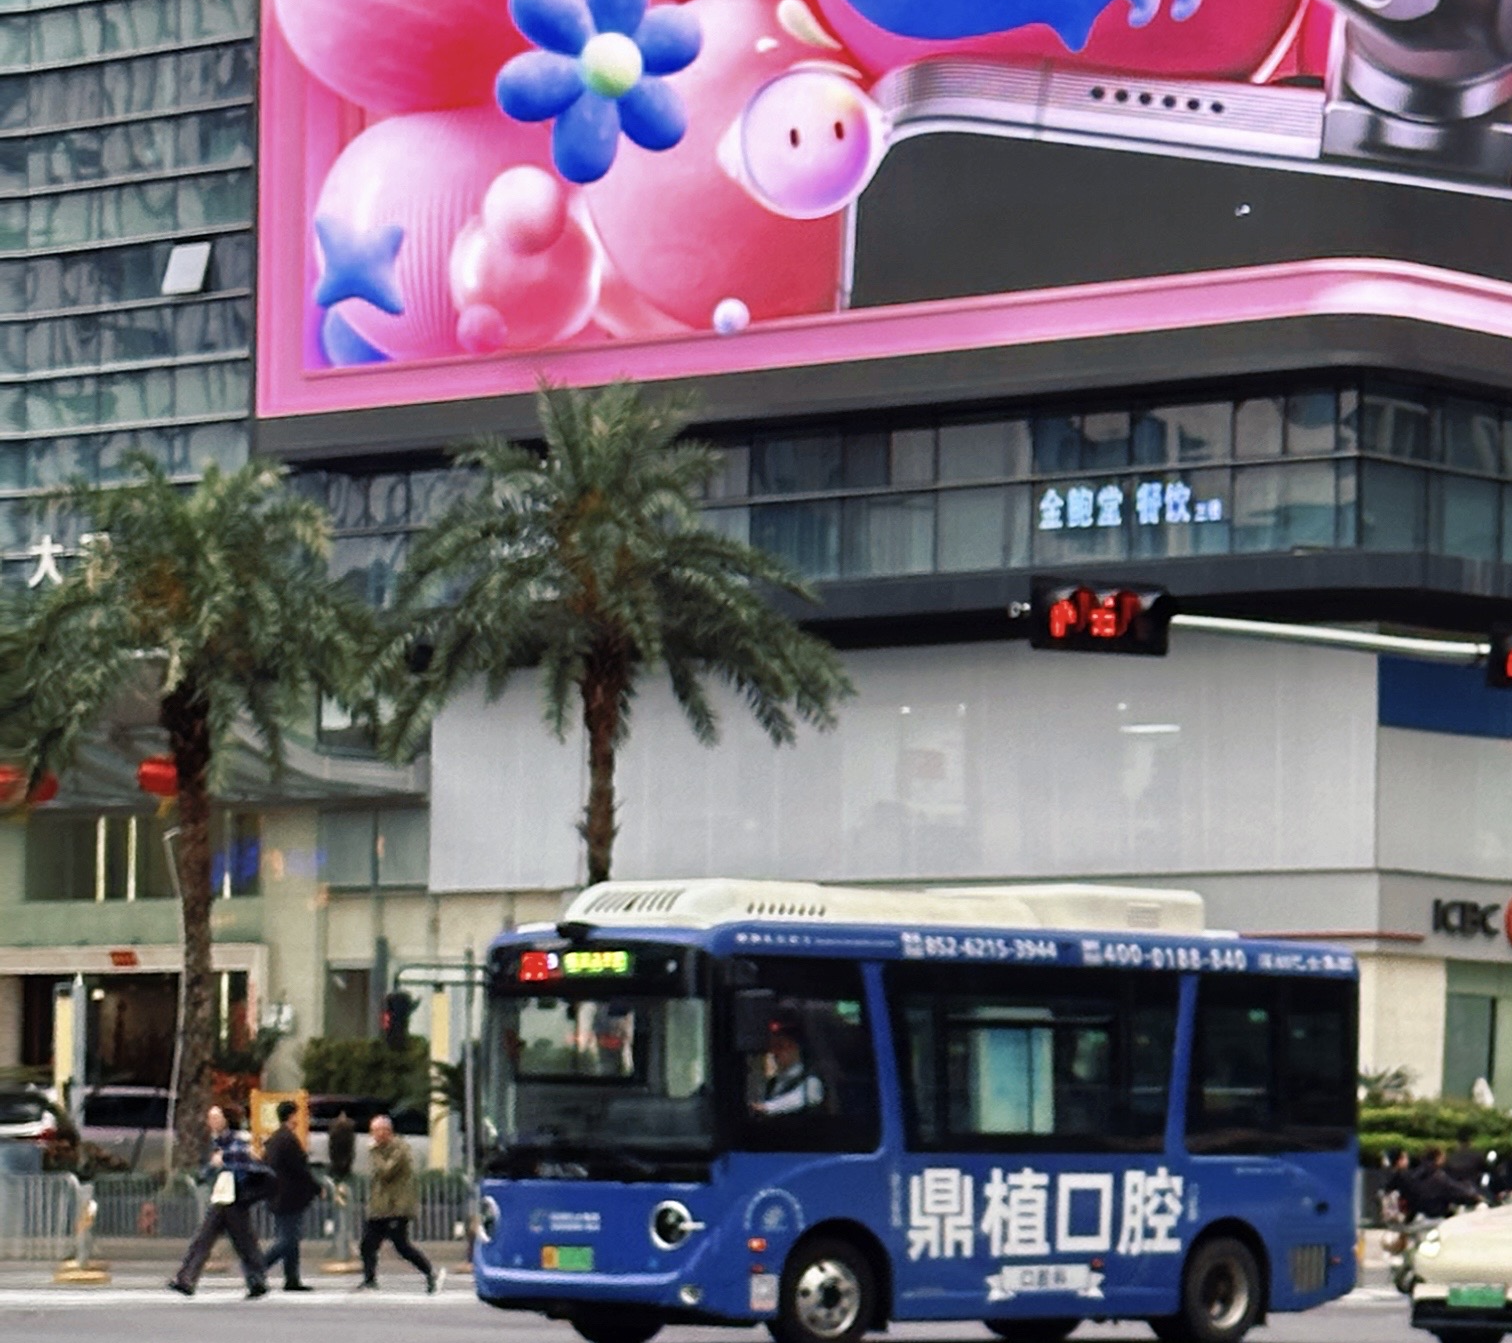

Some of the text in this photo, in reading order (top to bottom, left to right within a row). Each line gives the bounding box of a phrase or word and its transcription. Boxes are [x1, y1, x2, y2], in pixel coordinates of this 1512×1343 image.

[1432, 898, 1500, 937] ICBC
[1104, 943, 1248, 972] 400-0188-840
[907, 1166, 1184, 1262] 鼎植口腔
